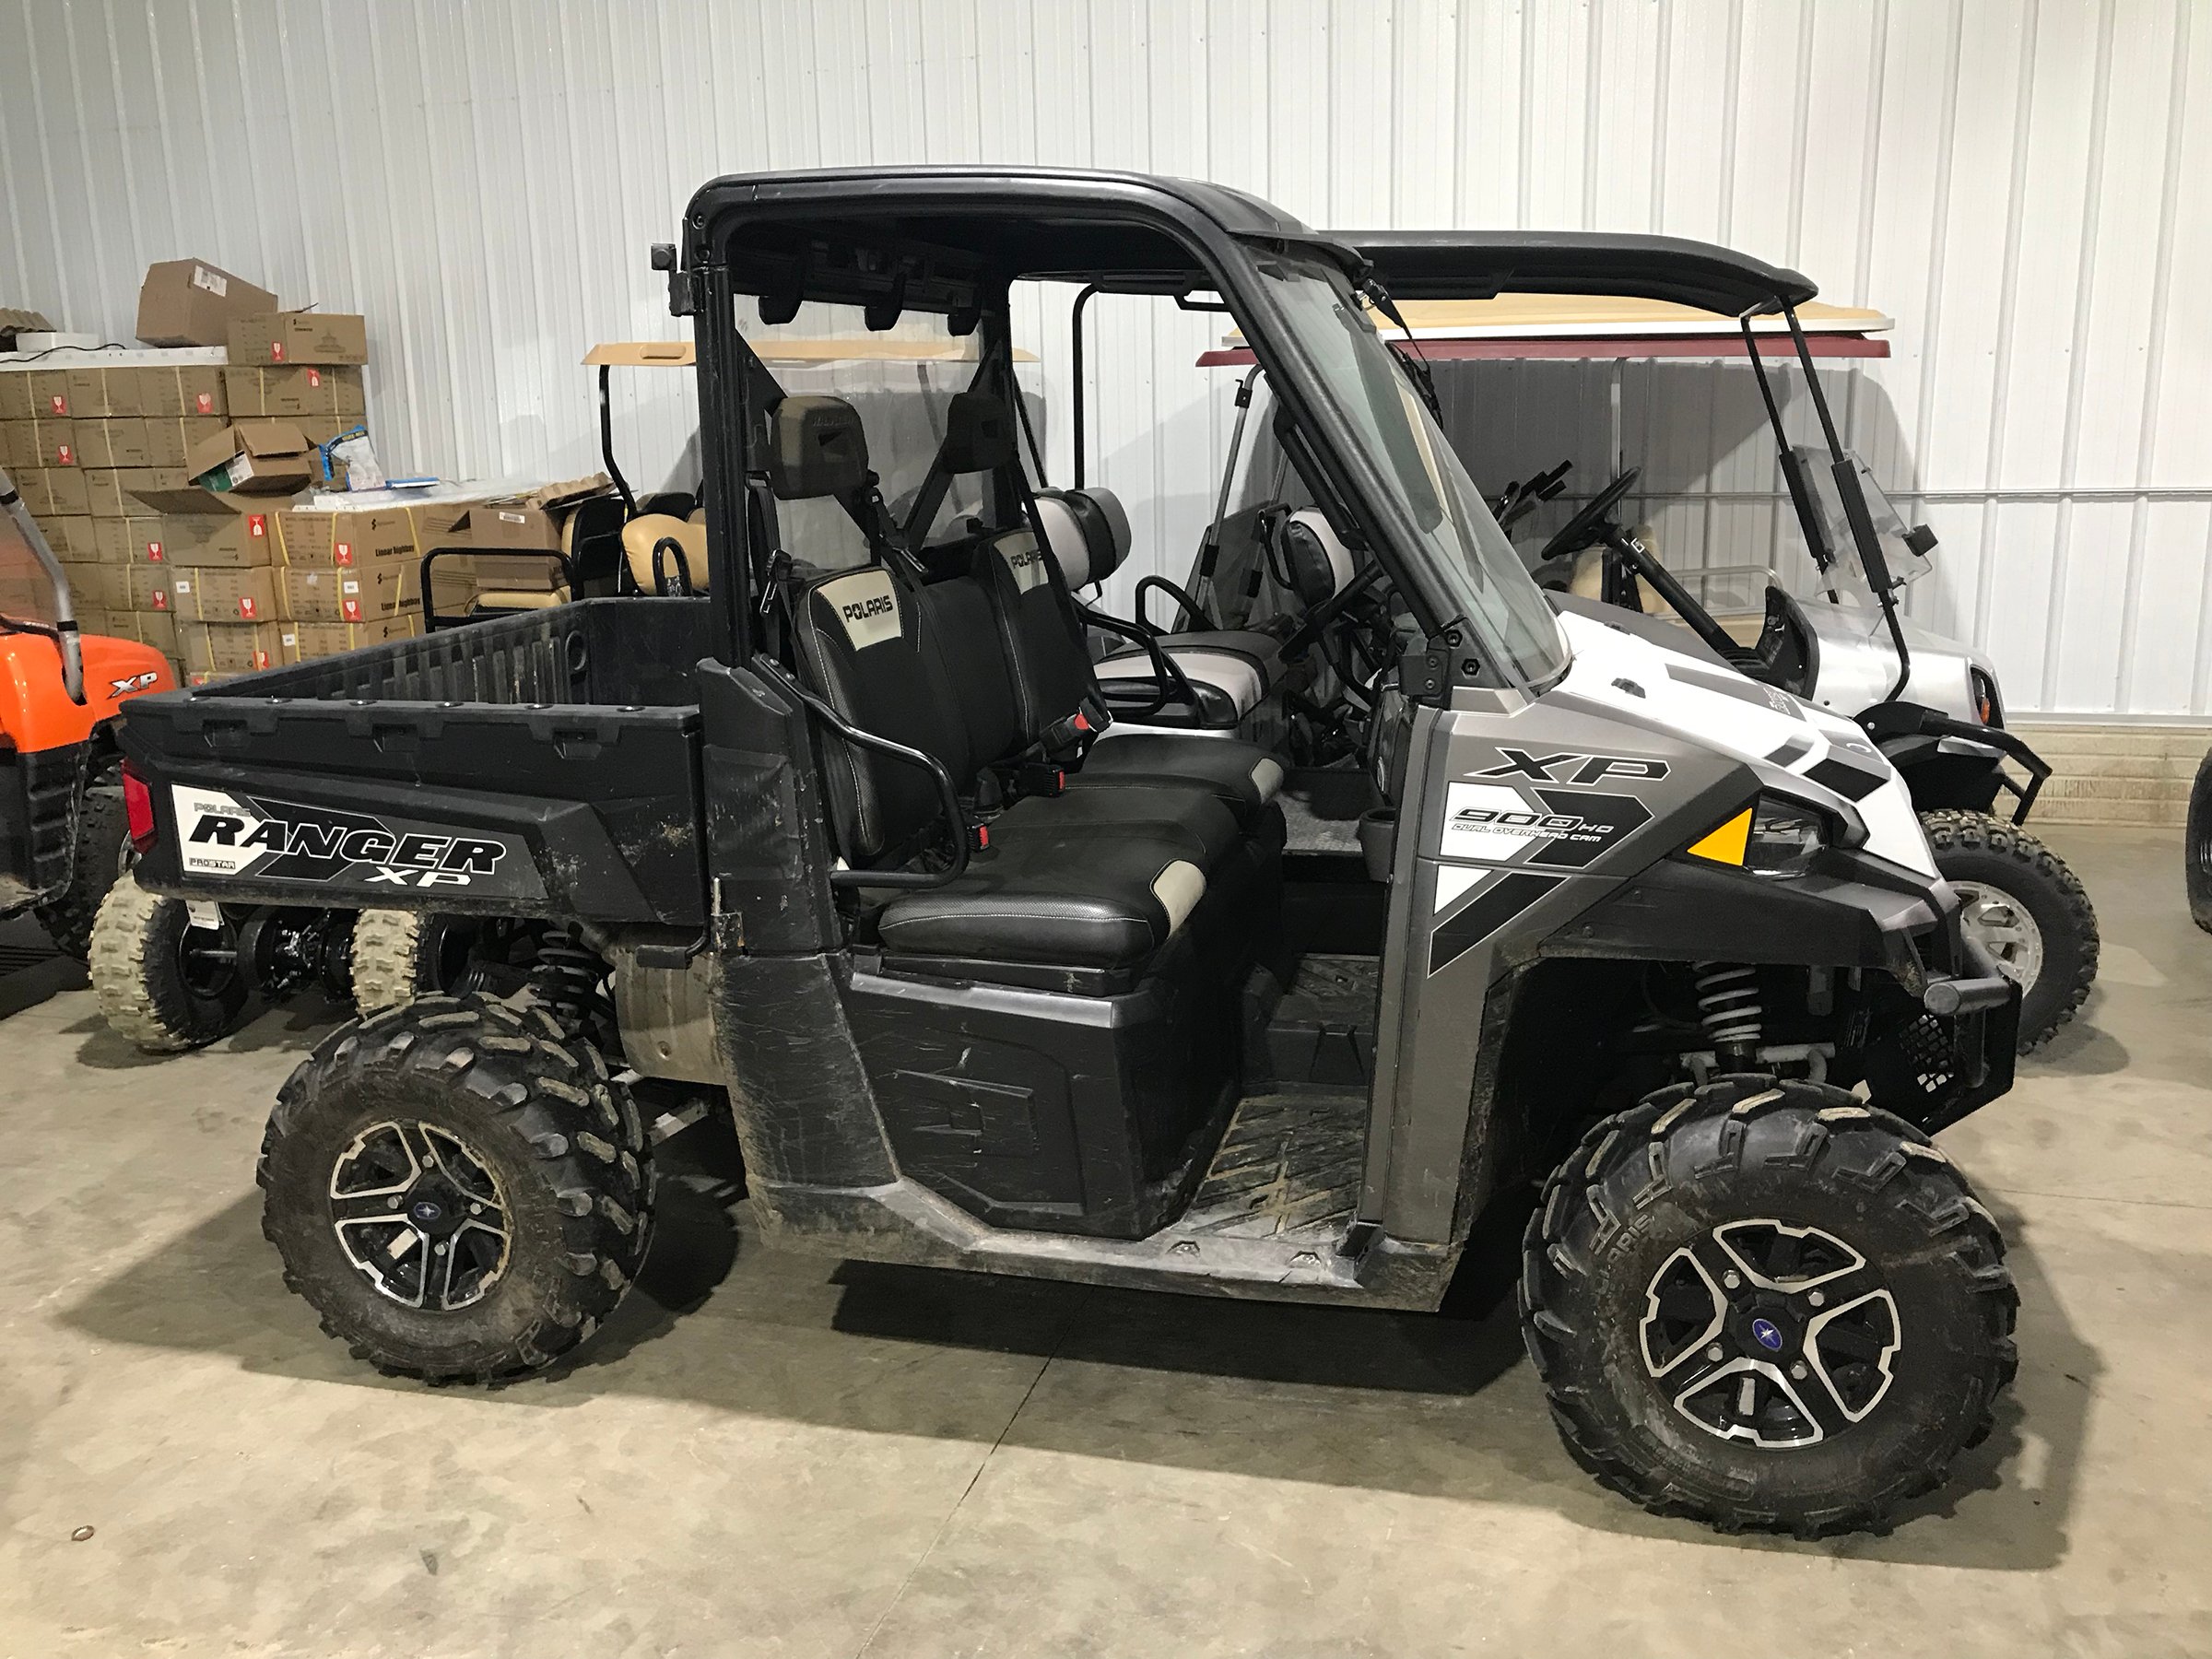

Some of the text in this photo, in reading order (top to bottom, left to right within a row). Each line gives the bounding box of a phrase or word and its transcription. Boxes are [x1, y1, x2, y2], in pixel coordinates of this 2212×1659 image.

[842, 595, 893, 622] POLARIS
[107, 671, 158, 700] XP
[1463, 747, 1671, 785] XP
[194, 802, 252, 818] POLARIS
[1450, 807, 1615, 834] 900 HO
[188, 815, 507, 875] RANGER
[1452, 823, 1602, 842] DUAL OVERHEAD CAM
[189, 857, 236, 870] PROSTAR
[363, 865, 473, 888] XP
